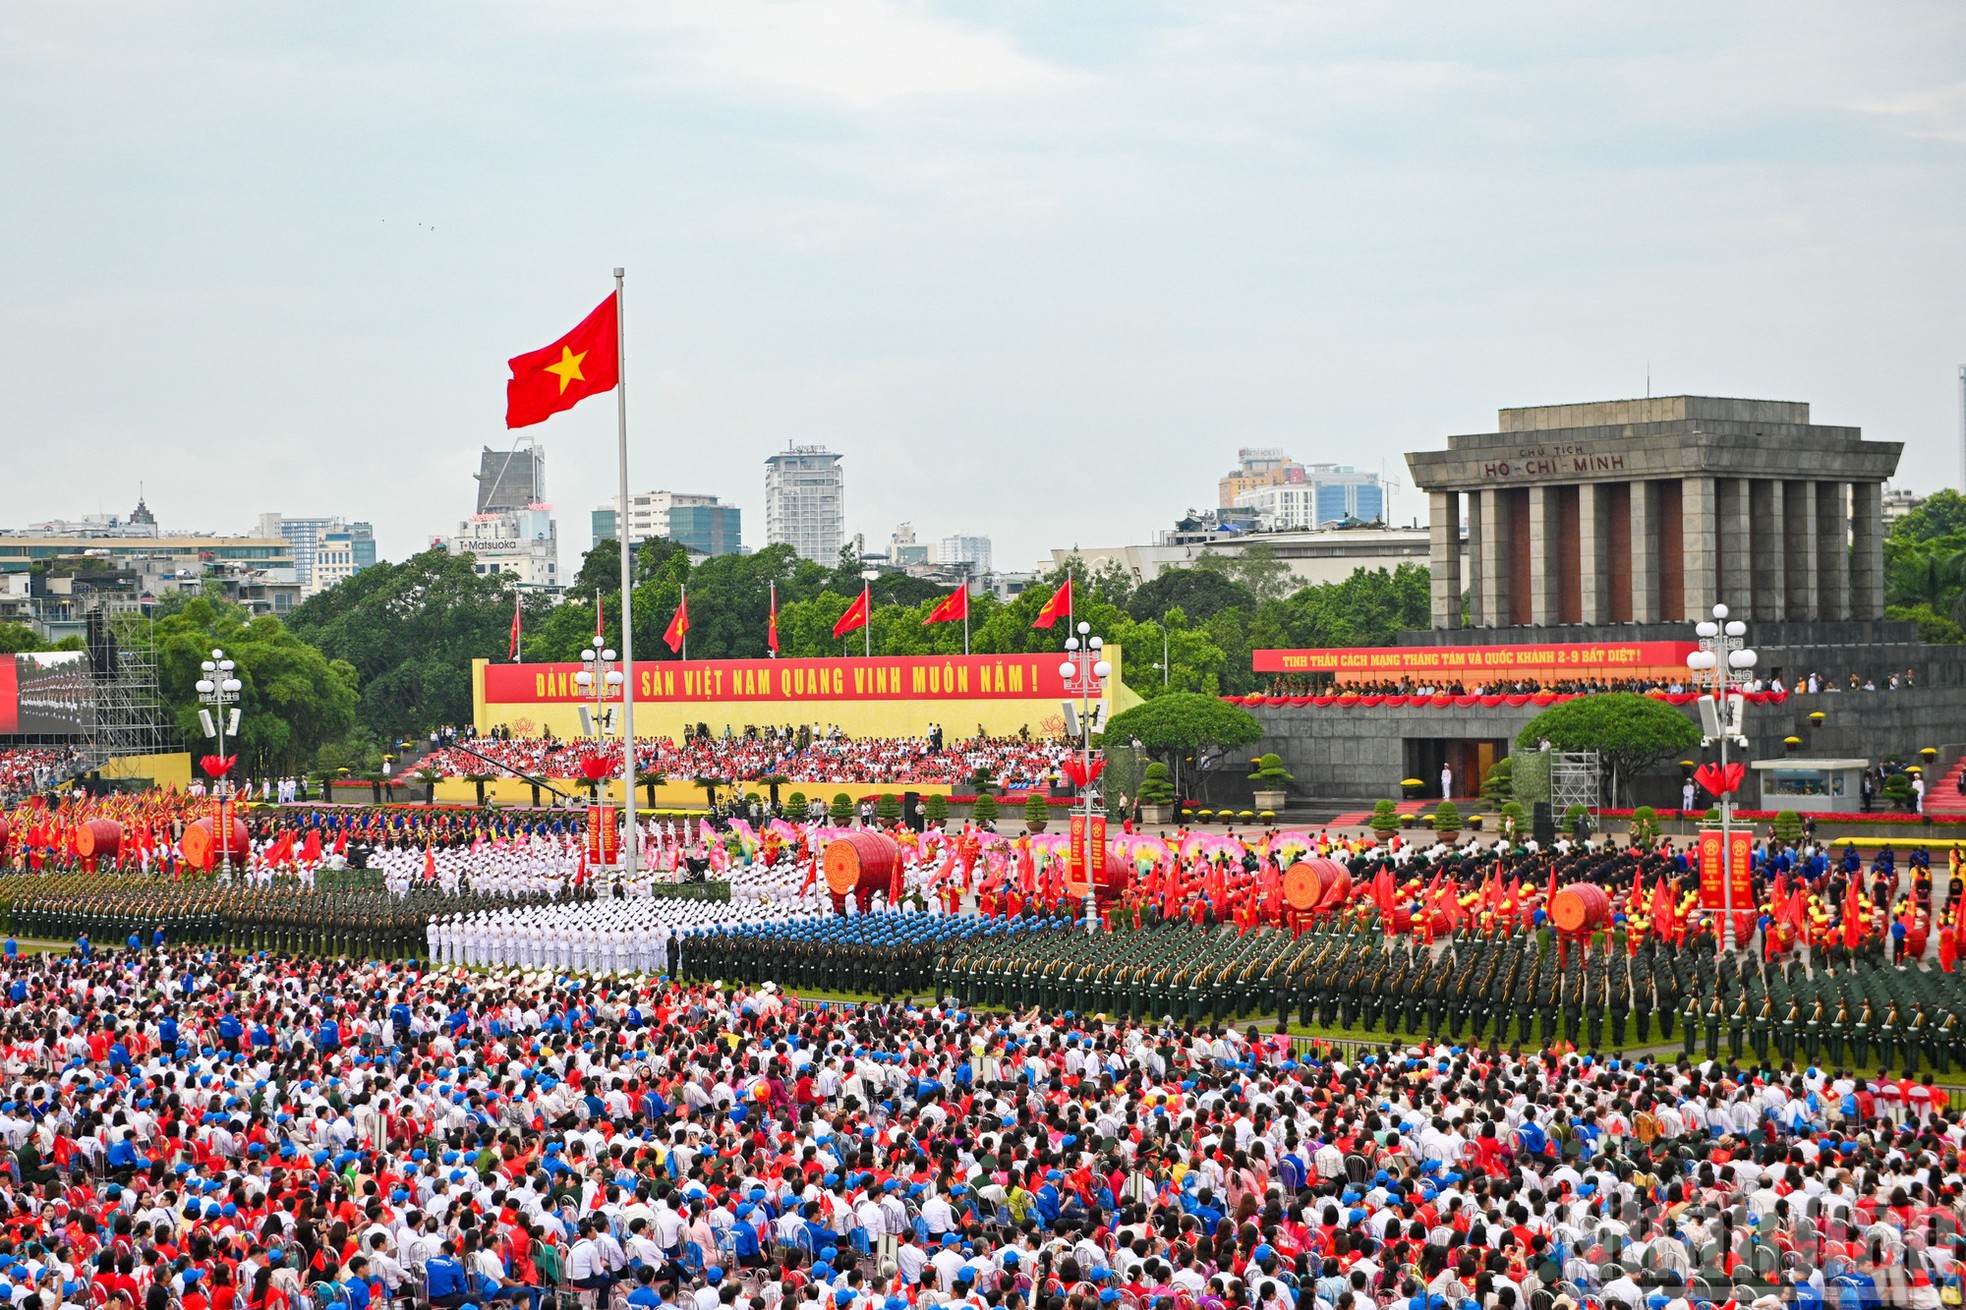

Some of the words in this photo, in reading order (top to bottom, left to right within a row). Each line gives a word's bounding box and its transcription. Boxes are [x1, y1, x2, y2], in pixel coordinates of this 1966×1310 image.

[468, 539, 517, 551] Matsuoka
[1283, 655, 1308, 668] TINH
[1340, 652, 1367, 667] CÁCH
[1370, 653, 1400, 668] MẠNG
[1402, 650, 1439, 666] THÁNG
[1441, 650, 1465, 665] TÁM
[1468, 649, 1483, 665] VÀ
[1485, 648, 1514, 665] QUỐC
[1516, 649, 1555, 664] KHÁNH
[1557, 650, 1579, 664] 2-9
[1581, 646, 1605, 663] BẤT
[641, 665, 675, 697] SẢN
[683, 666, 722, 699] VIỆT
[733, 669, 771, 695] NAM
[781, 667, 844, 697] QUANG
[854, 667, 901, 693] VINH
[912, 662, 969, 693] MUÔN
